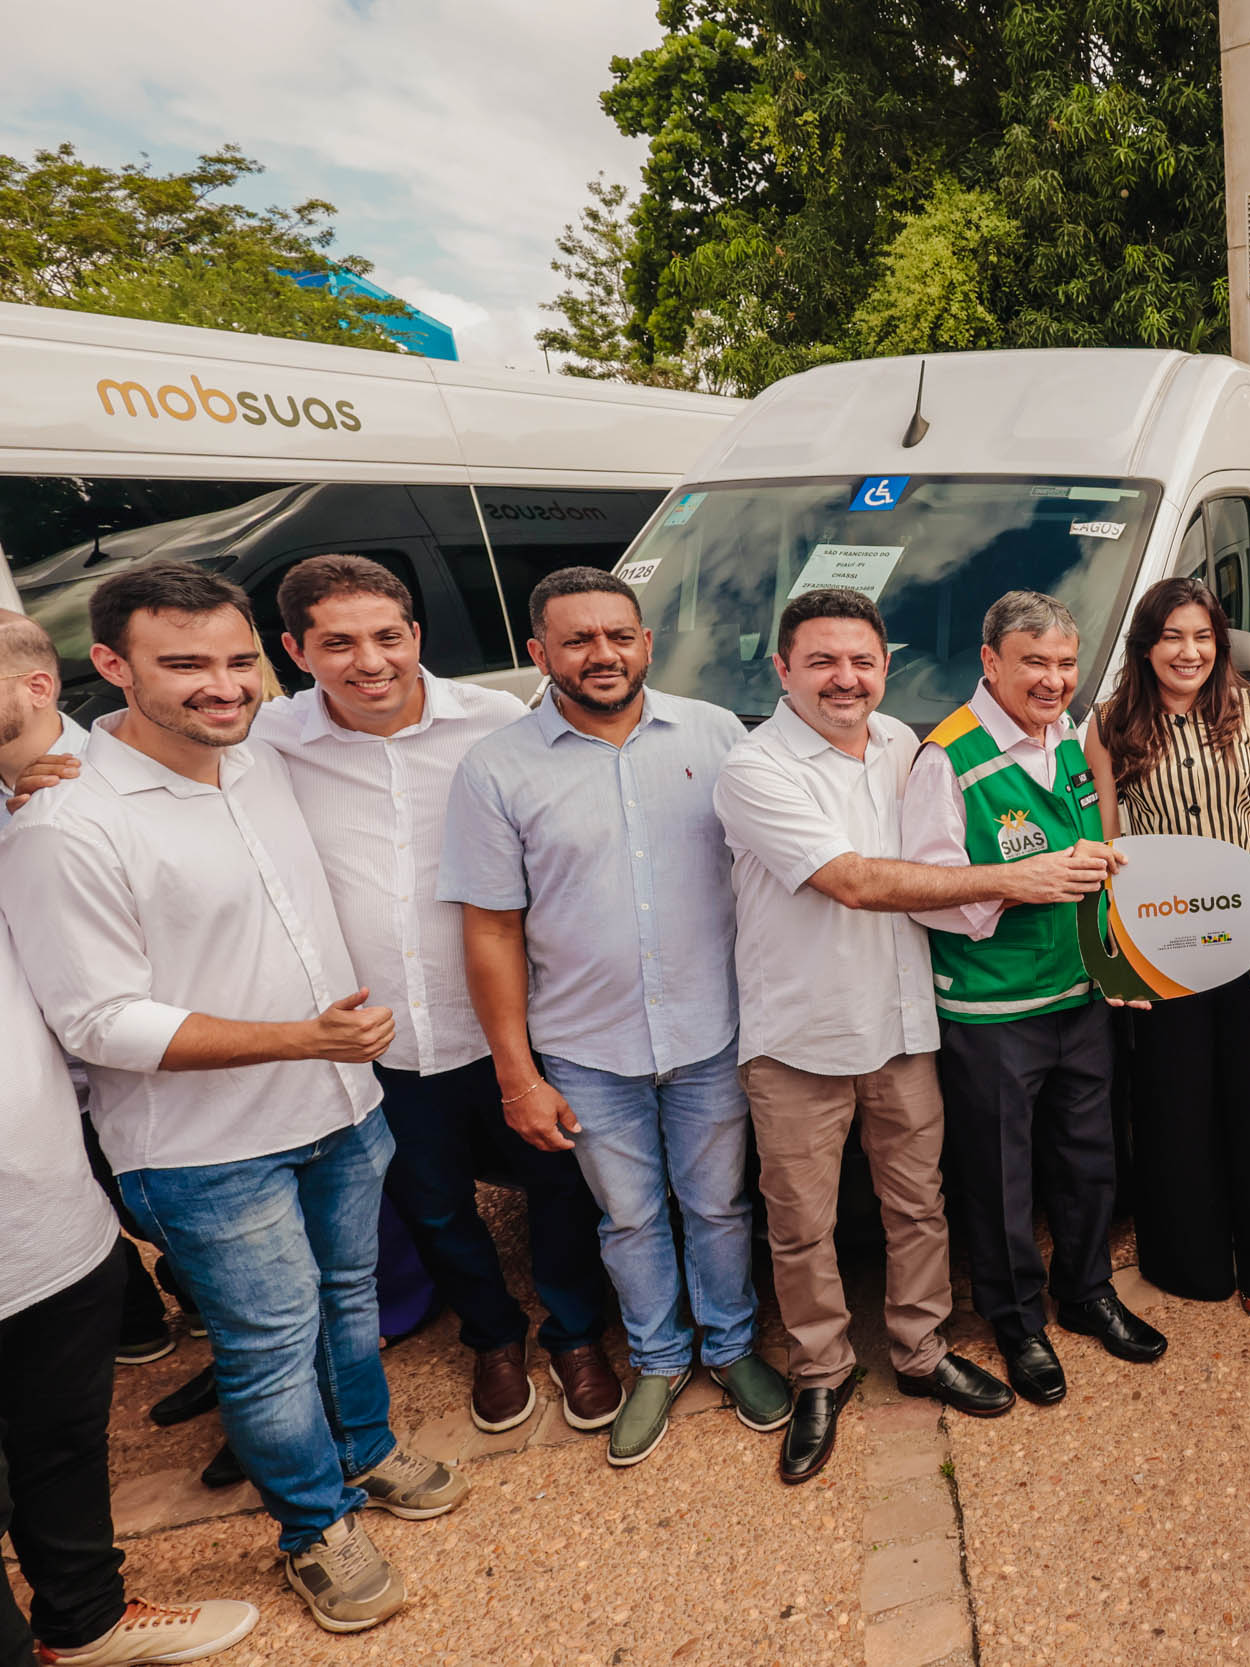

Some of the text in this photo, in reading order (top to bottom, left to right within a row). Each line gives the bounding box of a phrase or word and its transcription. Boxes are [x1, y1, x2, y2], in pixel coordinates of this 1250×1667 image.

[96, 374, 362, 432] mobsuas
[619, 564, 655, 580] 0128
[1001, 831, 1045, 855] SUAS
[1137, 895, 1242, 918] mobsuas
